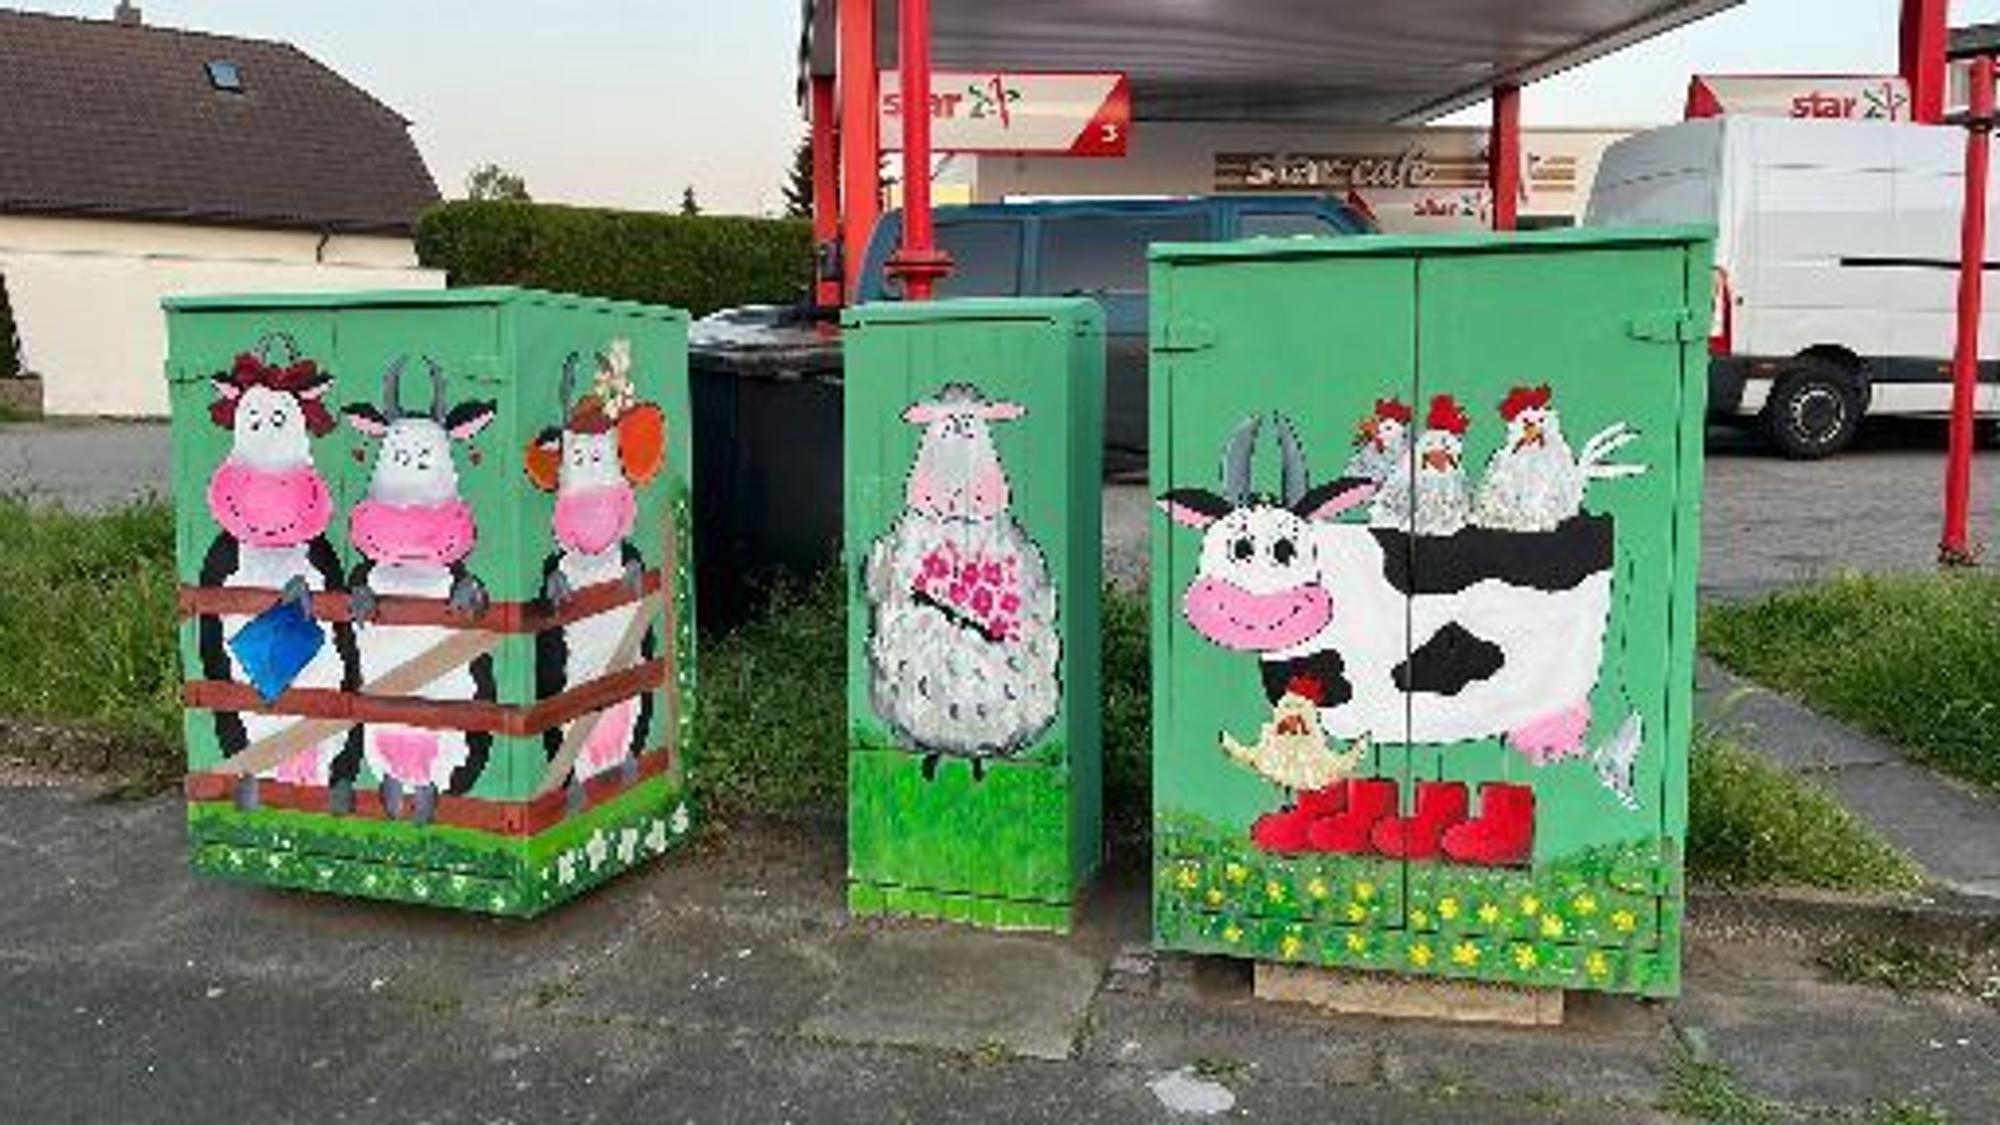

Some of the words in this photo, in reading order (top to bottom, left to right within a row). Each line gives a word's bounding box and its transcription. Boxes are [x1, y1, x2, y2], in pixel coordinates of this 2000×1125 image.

[883, 92, 962, 118] sar
[1791, 91, 1857, 118] star
[1100, 124, 1118, 142] 3
